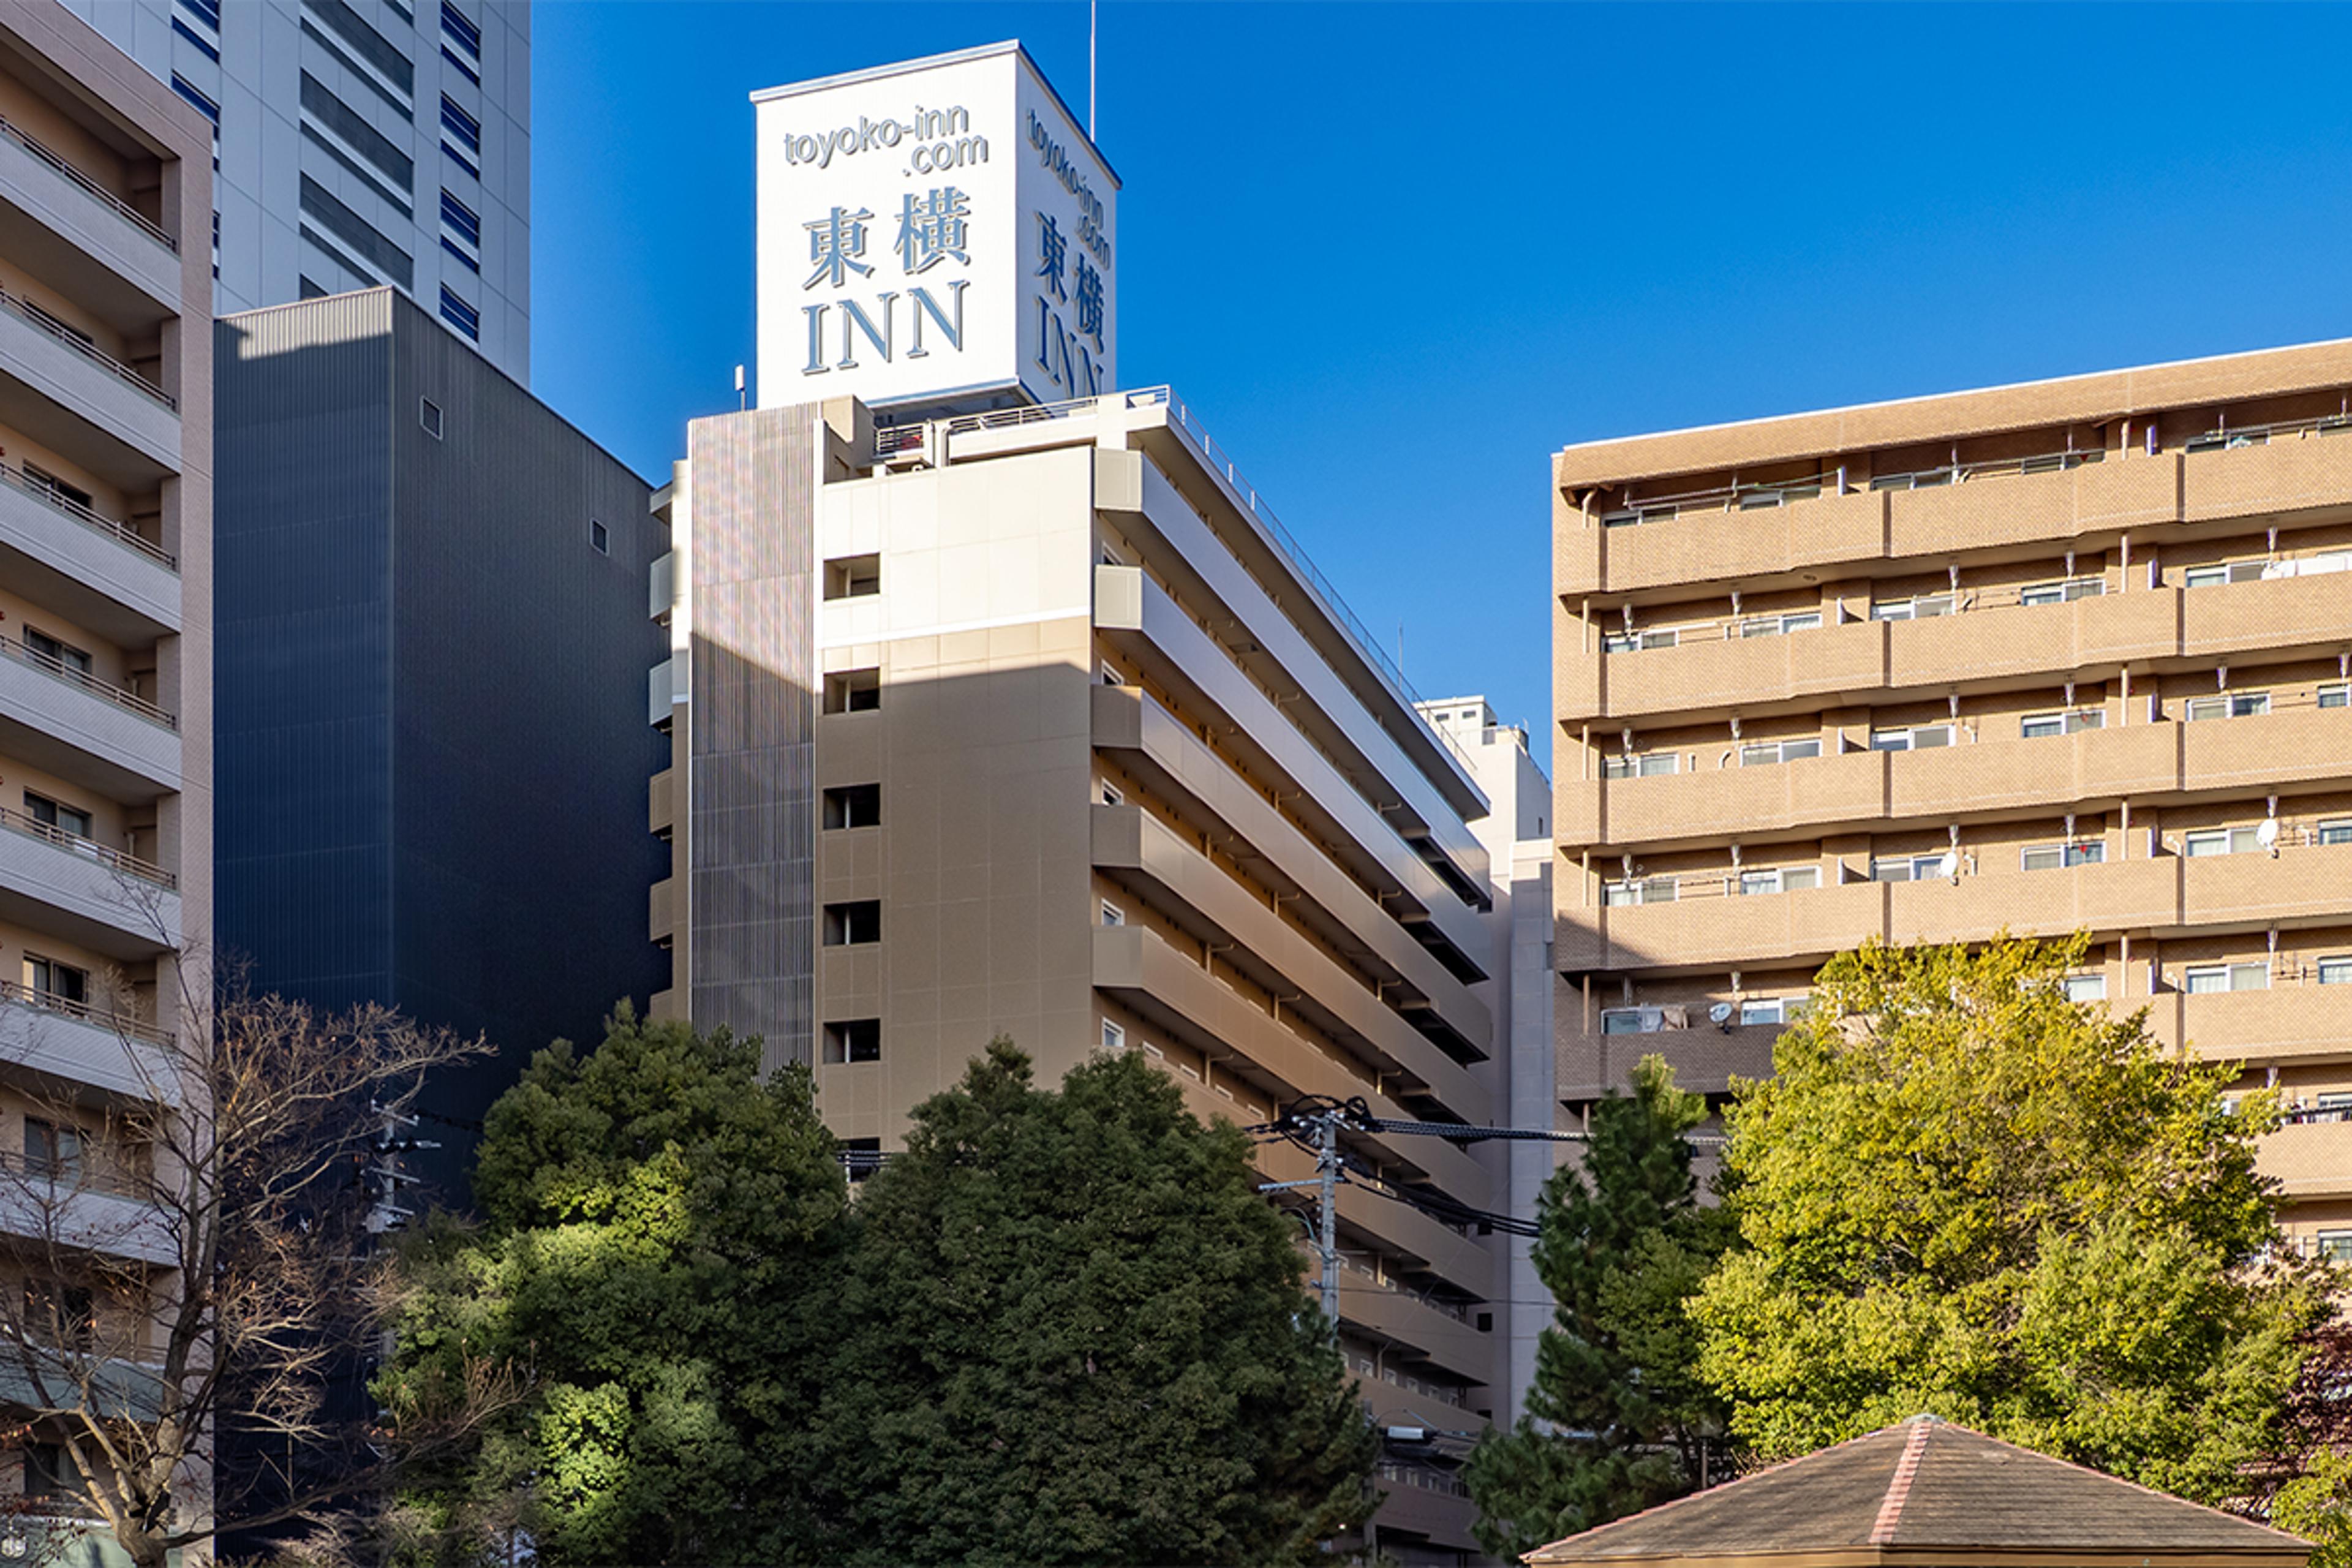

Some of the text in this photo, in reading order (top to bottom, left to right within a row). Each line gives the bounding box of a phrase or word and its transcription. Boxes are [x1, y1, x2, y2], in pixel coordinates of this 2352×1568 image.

[784, 104, 969, 170] toyoko-inn
[902, 135, 989, 177] .com
[1027, 108, 1104, 230] toyoko-inn
[802, 186, 972, 290] 東横
[1034, 211, 1104, 355] 東横
[801, 279, 970, 375] INN
